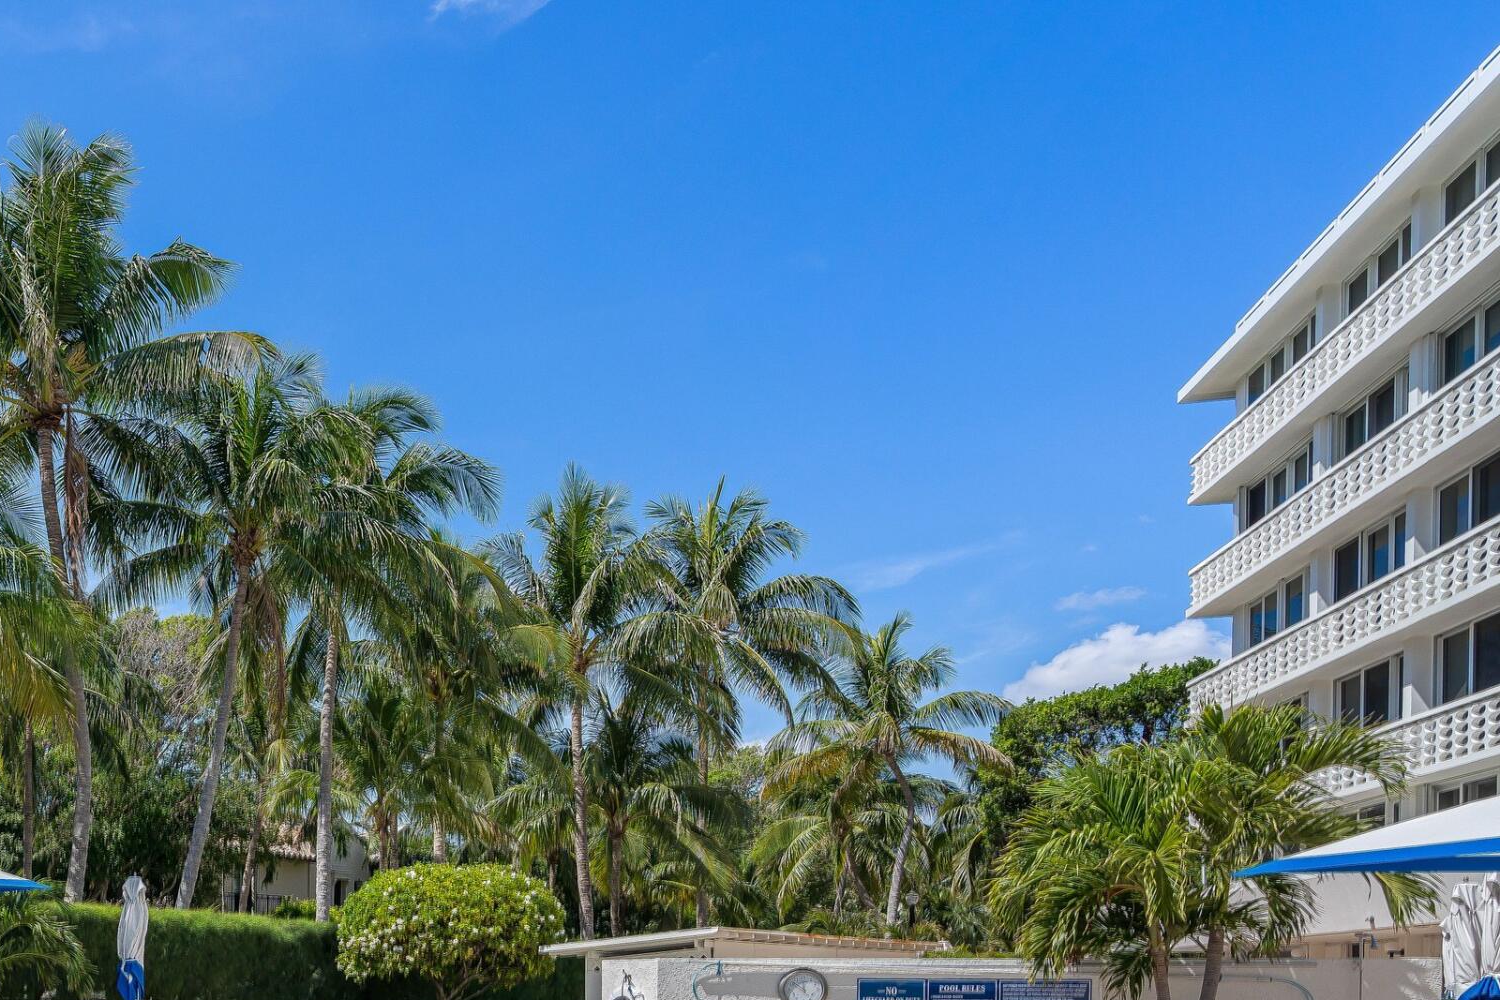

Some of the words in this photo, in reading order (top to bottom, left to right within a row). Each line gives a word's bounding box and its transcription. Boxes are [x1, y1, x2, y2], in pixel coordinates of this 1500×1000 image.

[885, 986, 898, 995] NO
[938, 984, 960, 992] POOL
[962, 984, 986, 992] RULES
